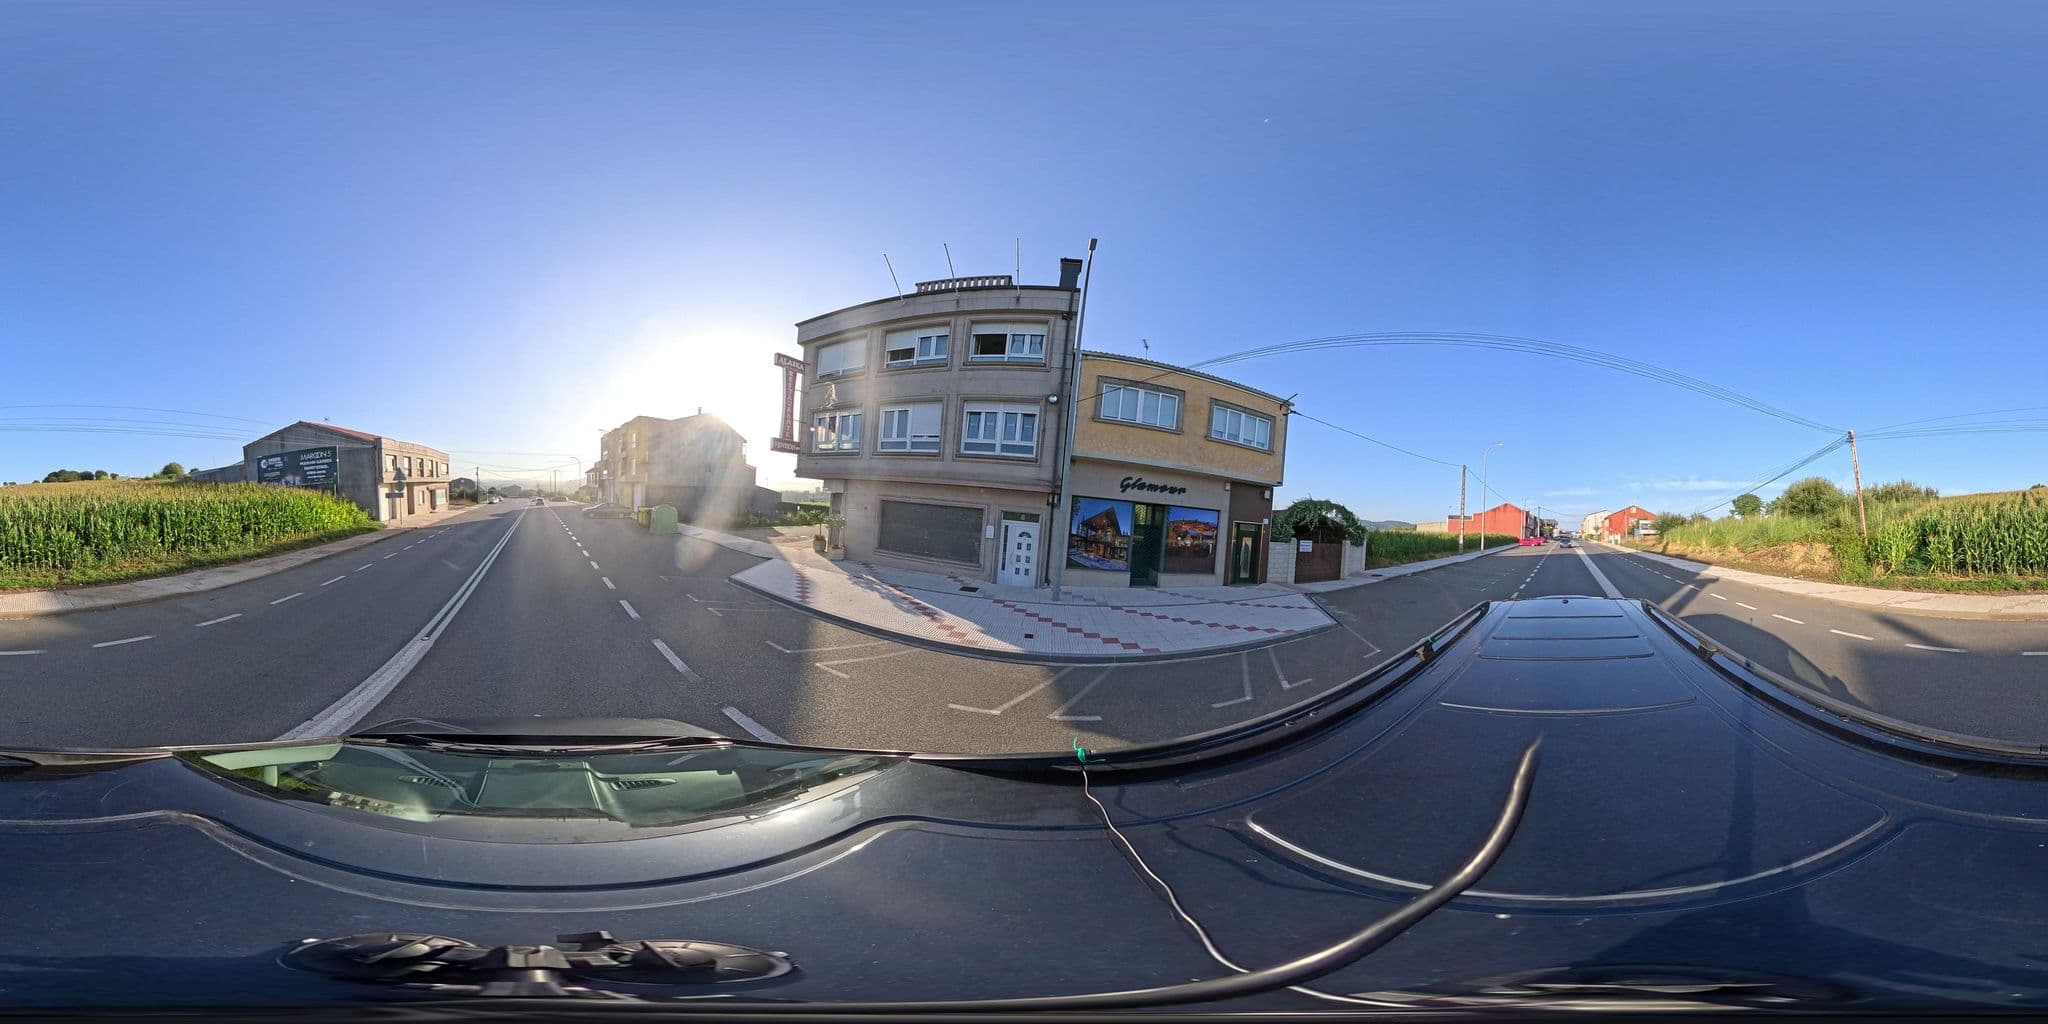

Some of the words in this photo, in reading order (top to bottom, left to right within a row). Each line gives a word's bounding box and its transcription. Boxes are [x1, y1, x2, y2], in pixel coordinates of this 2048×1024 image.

[779, 357, 805, 370] ALASKA
[786, 369, 794, 437] RESTAURANTE
[300, 451, 327, 460] MAROON
[1120, 477, 1186, 494] Glamour
